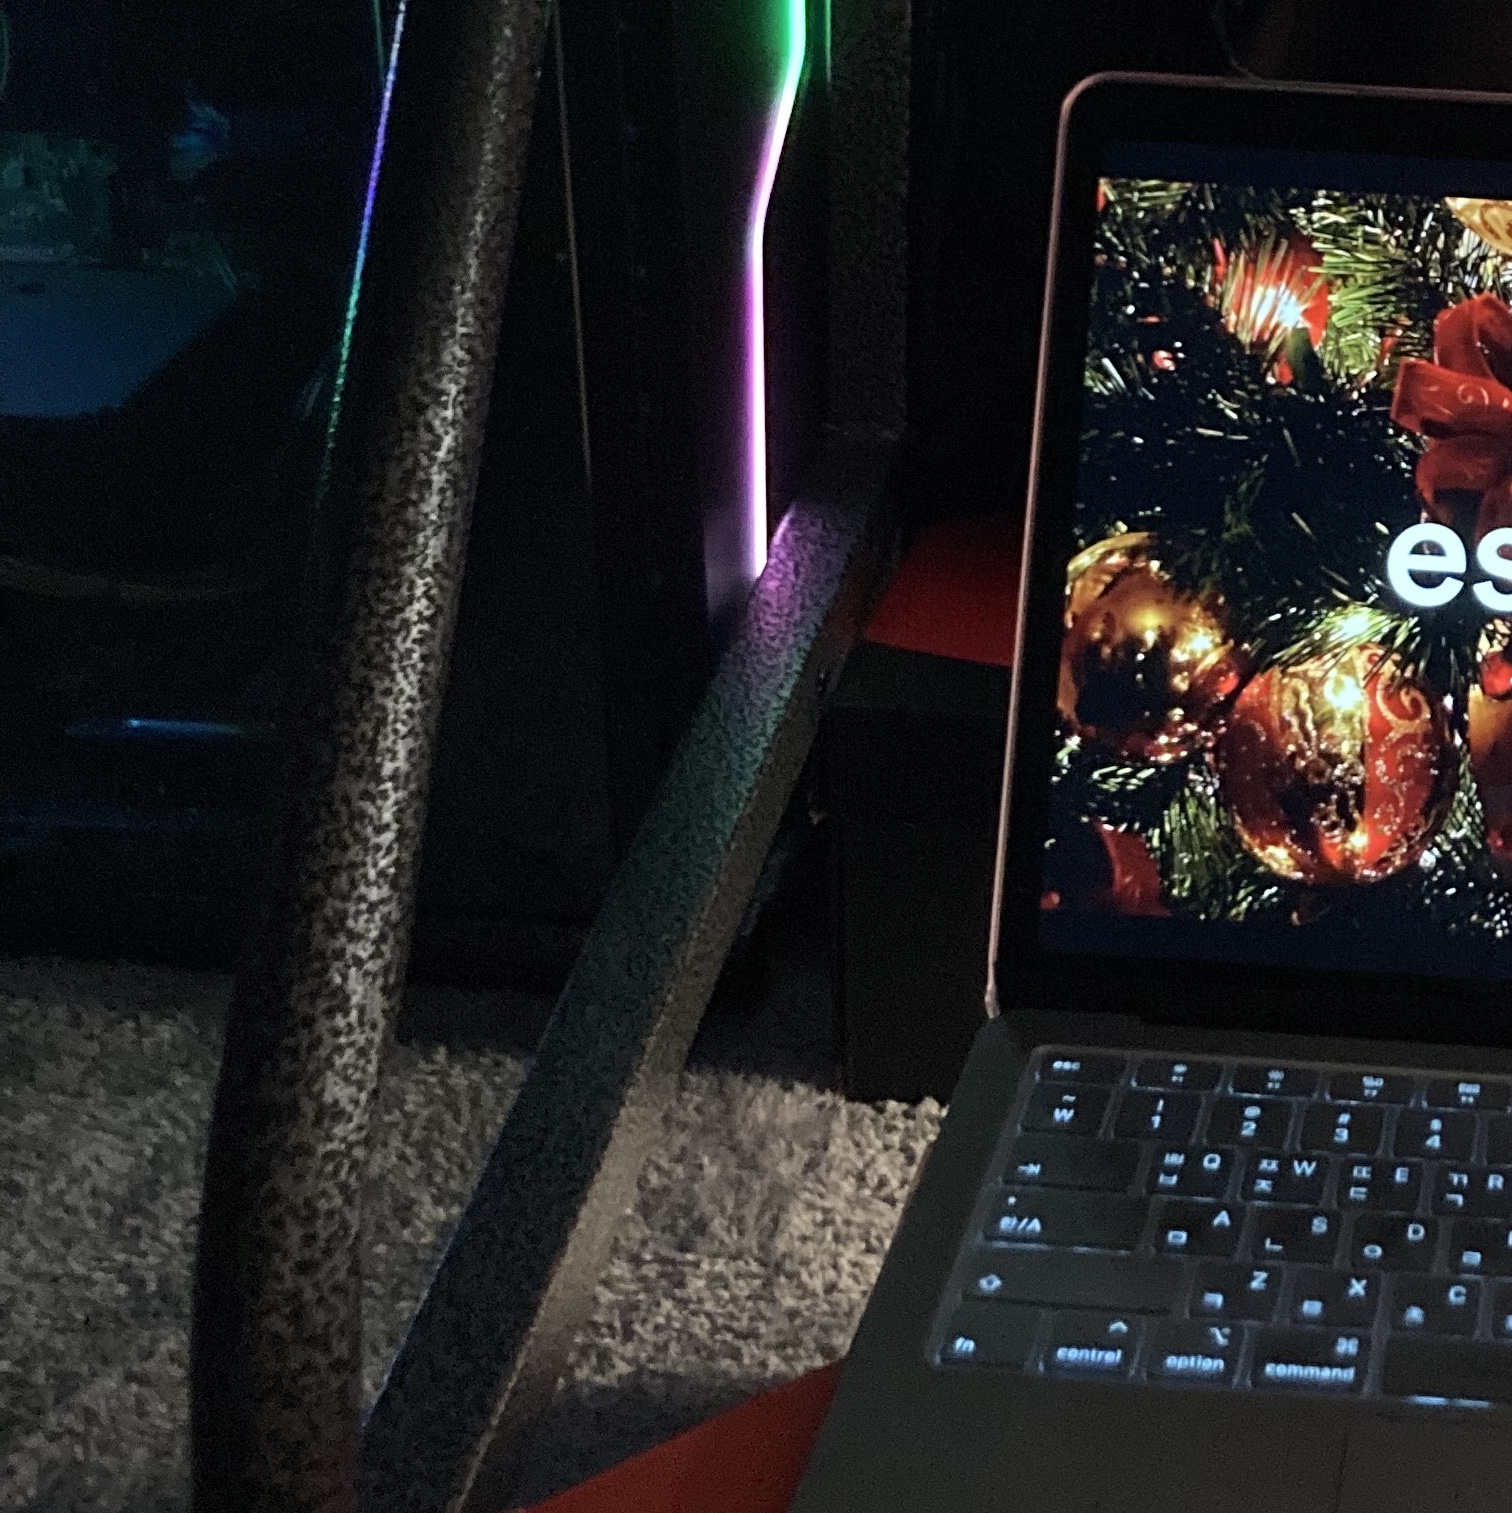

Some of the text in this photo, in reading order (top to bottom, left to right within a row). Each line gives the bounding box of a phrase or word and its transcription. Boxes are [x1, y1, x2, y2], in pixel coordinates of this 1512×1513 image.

[1293, 1160, 1316, 1176] W
[1394, 1167, 1409, 1183] E
[1487, 1174, 1504, 1190] R
[1212, 1210, 1230, 1227] A
[1311, 1216, 1328, 1234] S
[1406, 1223, 1425, 1240] D
[1249, 1271, 1268, 1289] Z
[1347, 1278, 1367, 1296] X
[1447, 1285, 1466, 1304] C
[1055, 1347, 1122, 1363] control
[1163, 1355, 1225, 1373] option
[1264, 1363, 1355, 1381] command
